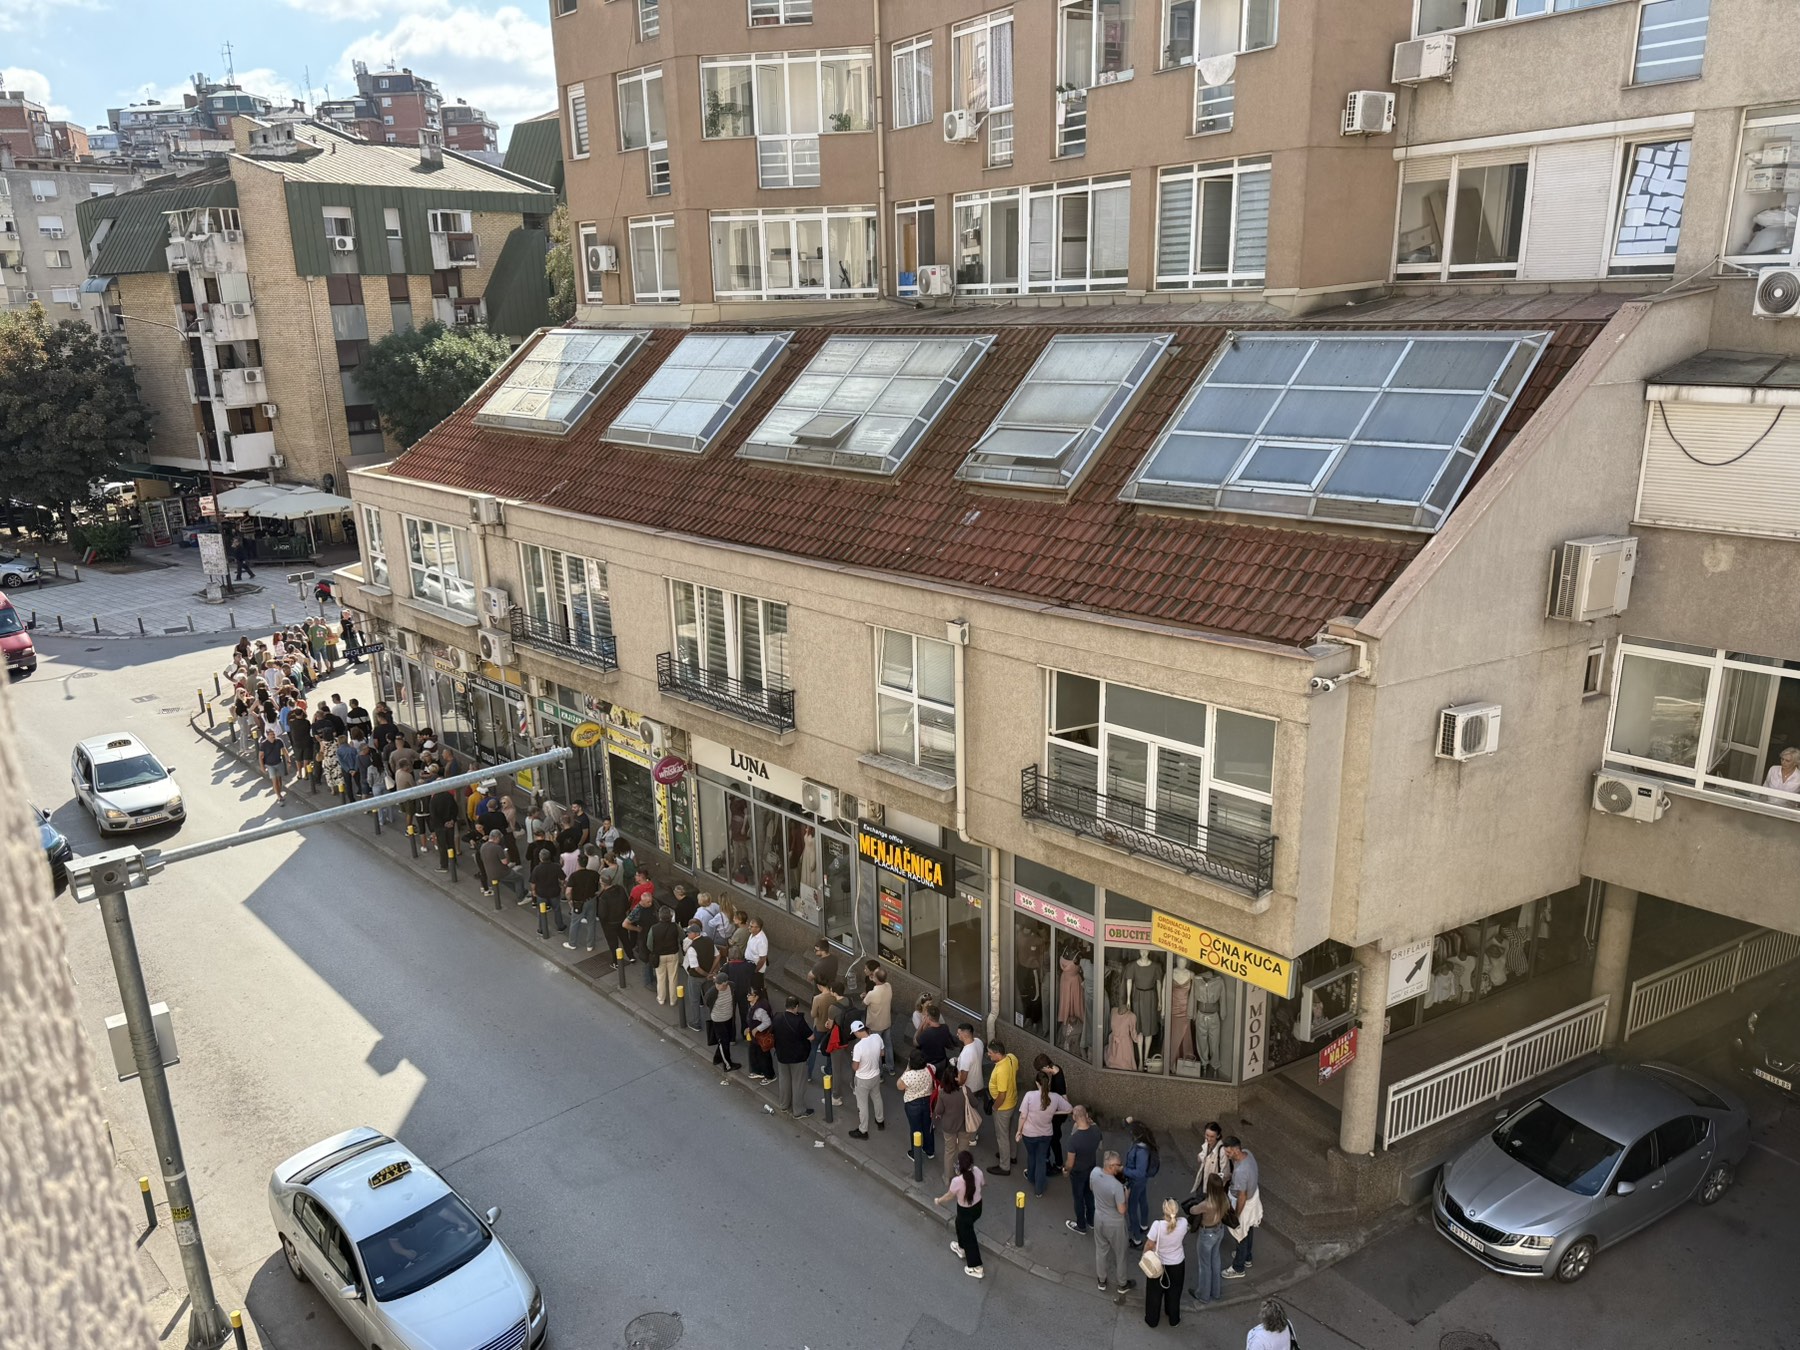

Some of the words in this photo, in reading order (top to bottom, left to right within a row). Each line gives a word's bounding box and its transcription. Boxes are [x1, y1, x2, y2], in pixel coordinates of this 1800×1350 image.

[730, 748, 769, 780] LUNA
[863, 823, 888, 839] Exchange
[889, 834, 903, 844] office
[859, 832, 943, 886] MENJAČNICA
[1108, 928, 1151, 941] OBUCITE
[1158, 916, 1190, 932] ORDINACIJA
[1163, 932, 1183, 944] OPTIKA
[1199, 932, 1240, 960] OČNA
[1243, 950, 1282, 976] KUĆA
[1391, 940, 1431, 960] ORIFLAME
[1200, 948, 1248, 977] FOKUS
[1329, 1040, 1349, 1065] NAJS
[379, 1165, 405, 1182] TAXI
